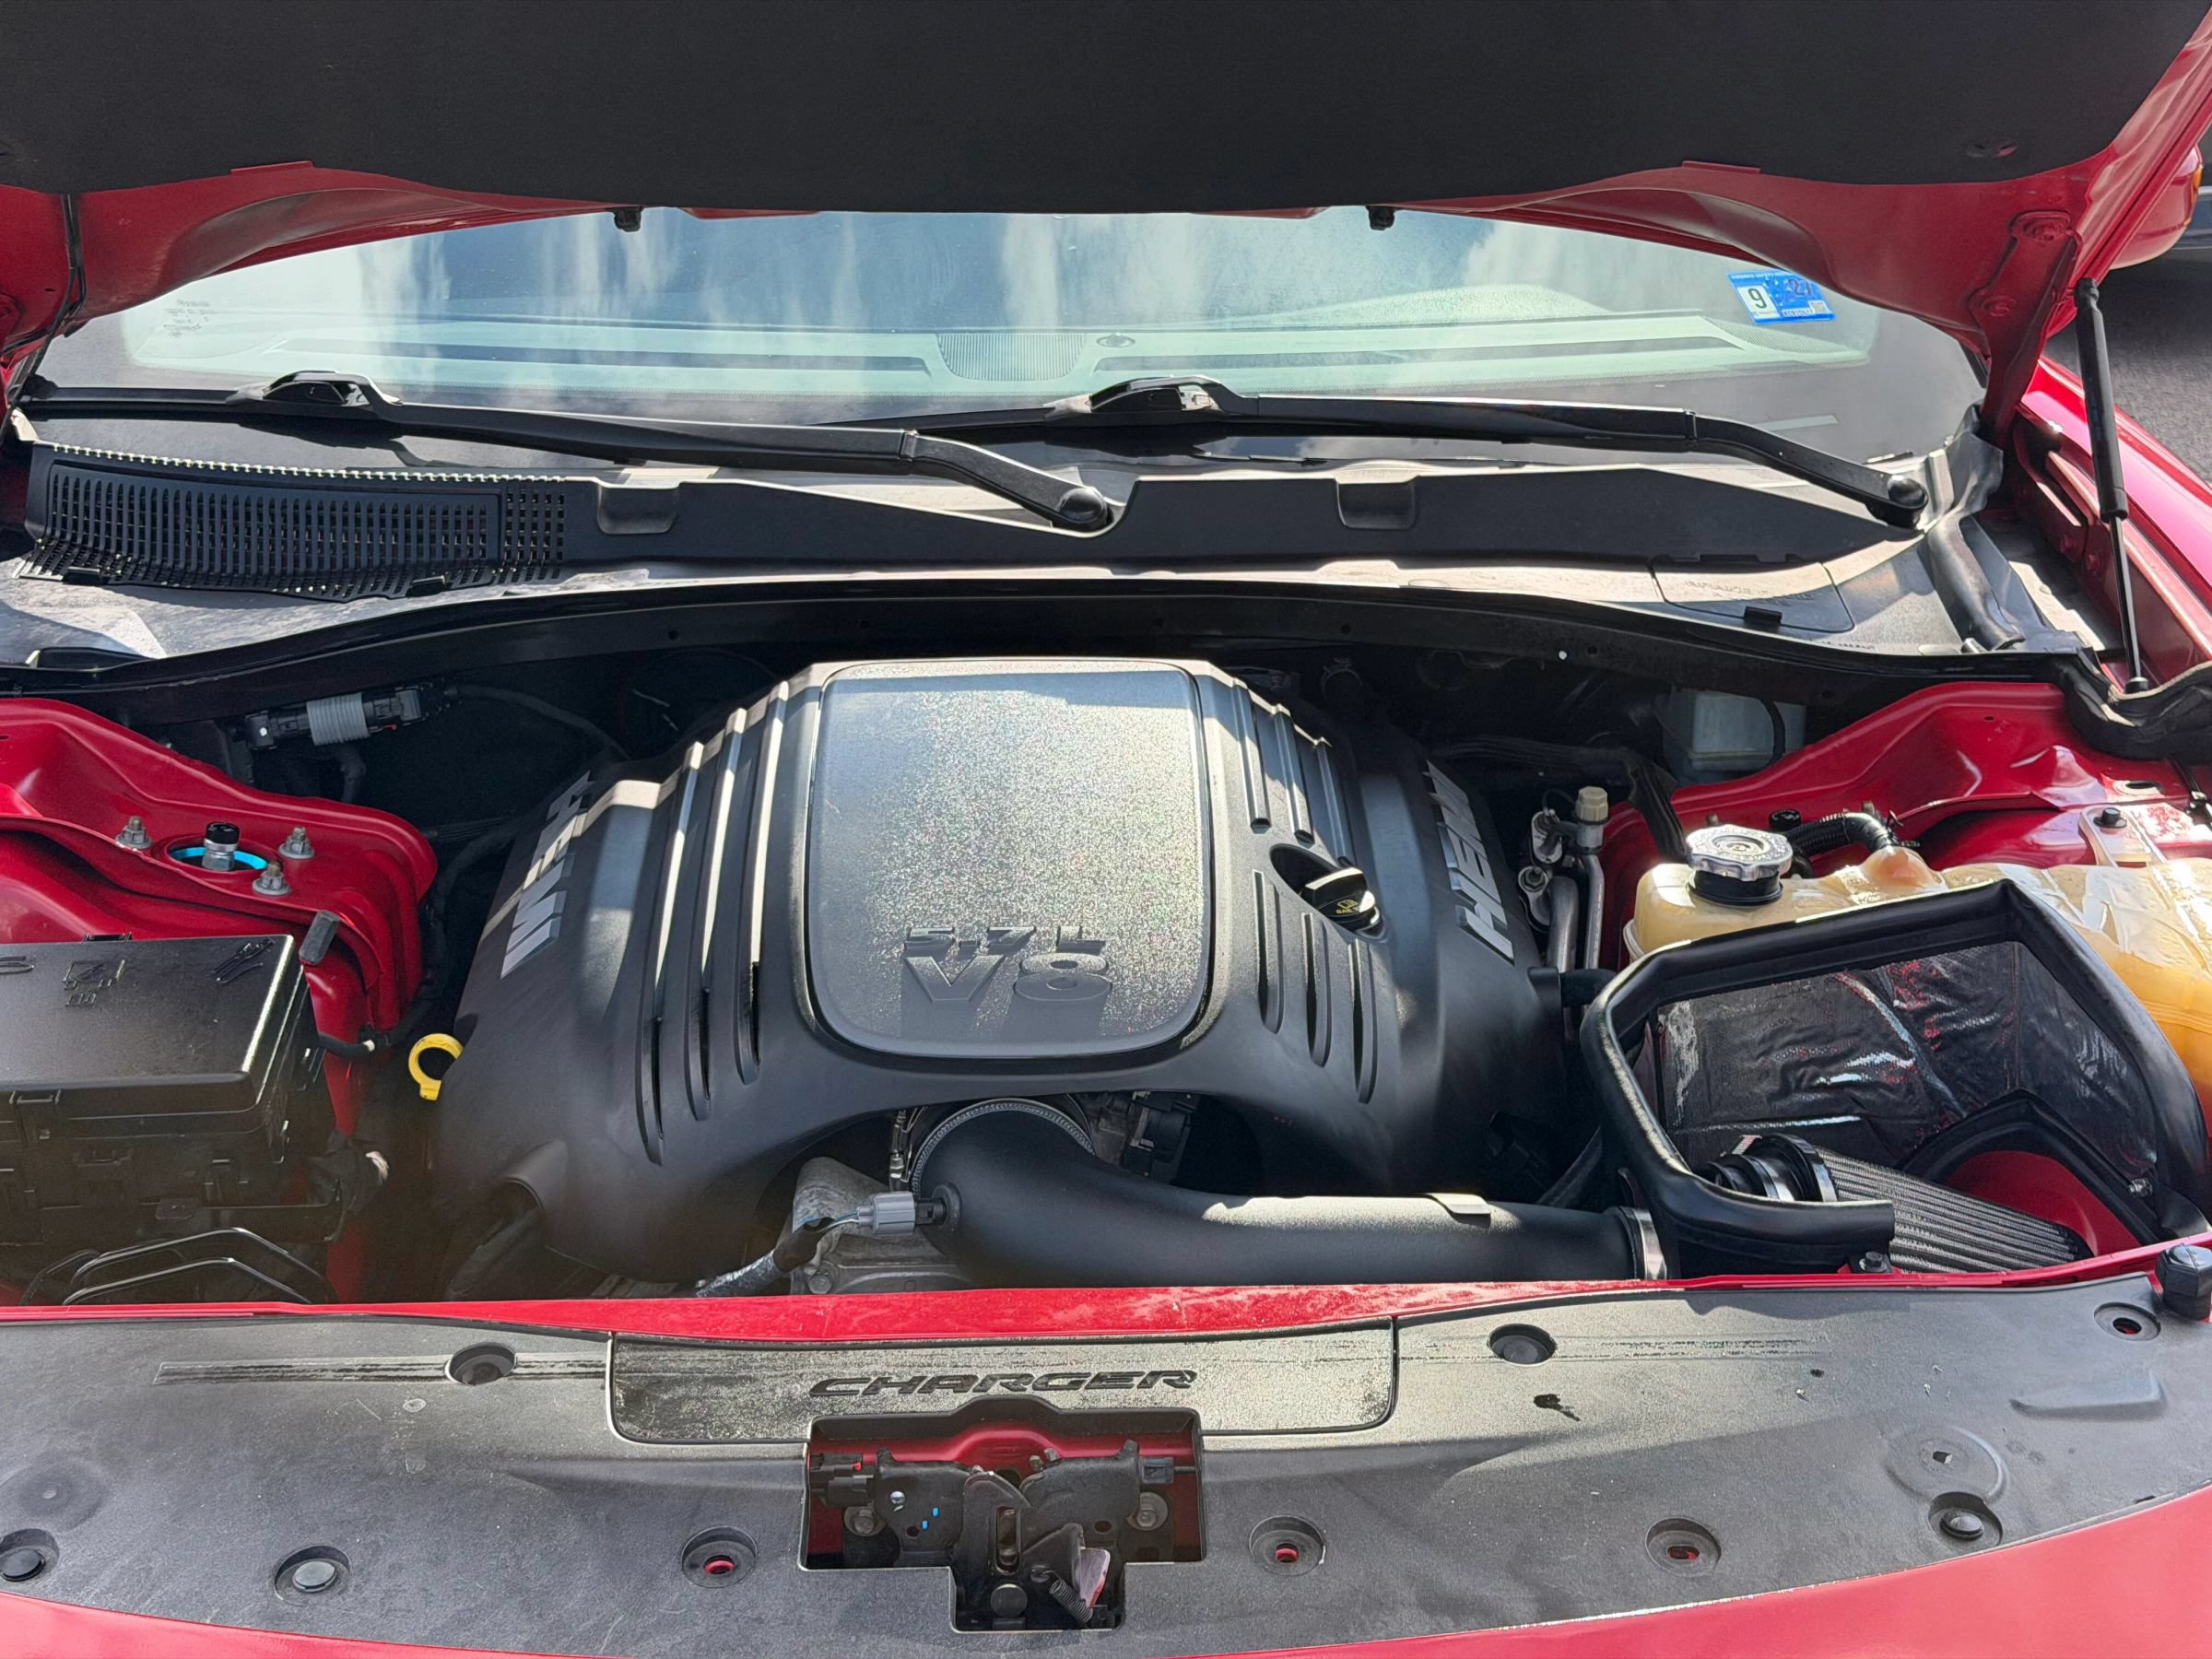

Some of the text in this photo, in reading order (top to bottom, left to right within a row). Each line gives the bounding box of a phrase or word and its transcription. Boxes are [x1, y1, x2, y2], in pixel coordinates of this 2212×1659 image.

[1747, 288, 1768, 309] 9
[1422, 759, 1515, 963] HEMI
[903, 952, 1113, 1003] V8
[808, 1370, 1198, 1397] CHARGER
